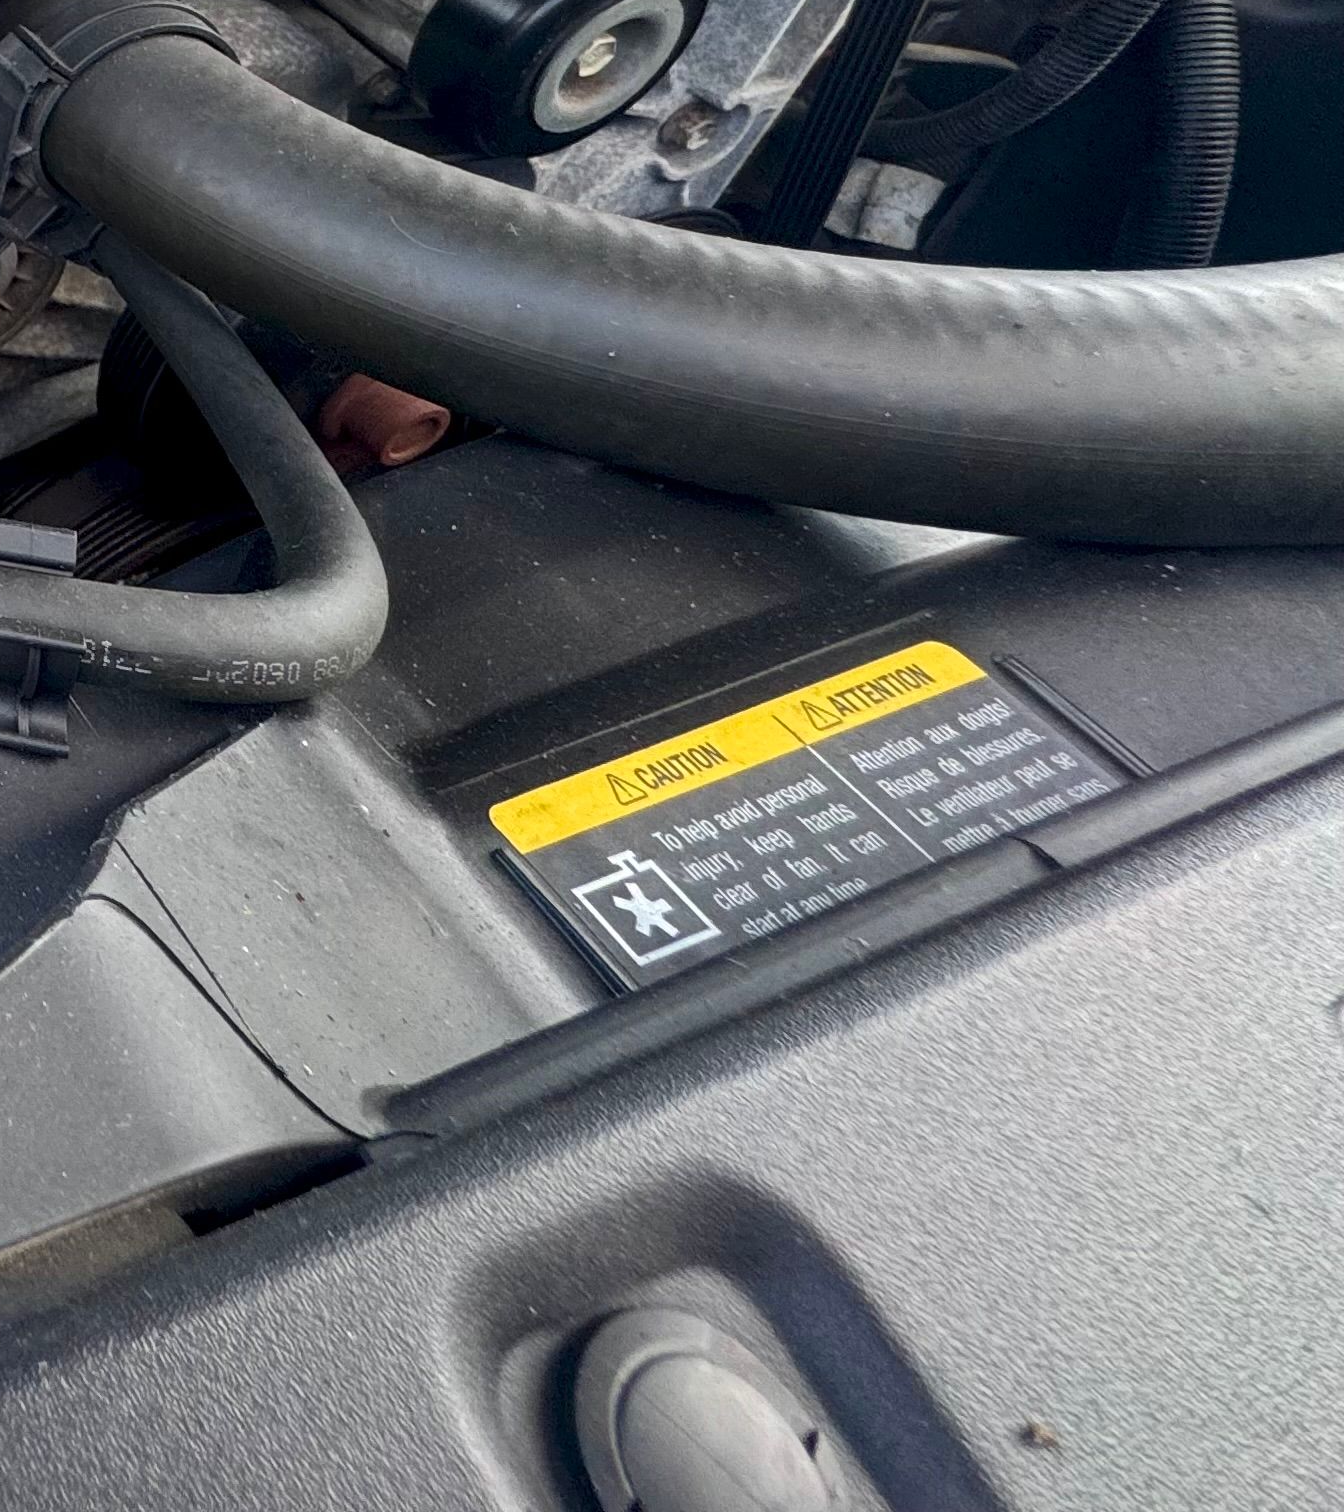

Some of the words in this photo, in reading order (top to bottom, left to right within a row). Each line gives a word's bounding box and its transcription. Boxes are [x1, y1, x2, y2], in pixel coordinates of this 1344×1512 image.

[825, 662, 937, 718] ATTENTION
[633, 741, 729, 790] CAUTION
[848, 735, 927, 775] Attention
[923, 721, 962, 746] aux
[957, 696, 1016, 732] doigts!
[875, 767, 942, 800] Risque
[937, 754, 967, 778] de
[959, 725, 1047, 767] blessures.
[651, 830, 684, 852] To
[673, 818, 720, 847] help
[713, 797, 763, 832] avoid
[755, 772, 830, 818] personal
[905, 806, 941, 828] Le
[934, 774, 1017, 818] ventilateur
[1013, 757, 1058, 788] peut
[1049, 750, 1079, 771] se
[941, 821, 1002, 855] mettre
[1007, 791, 1071, 827] tourner
[1064, 776, 1113, 802] sans
[679, 850, 745, 884] injury,
[741, 827, 797, 857] keep
[795, 801, 859, 835] hands
[712, 879, 761, 912] clear
[761, 866, 789, 891] of
[822, 842, 852, 865] It
[848, 830, 889, 856] can
[740, 909, 784, 940] start
[780, 901, 804, 924] at
